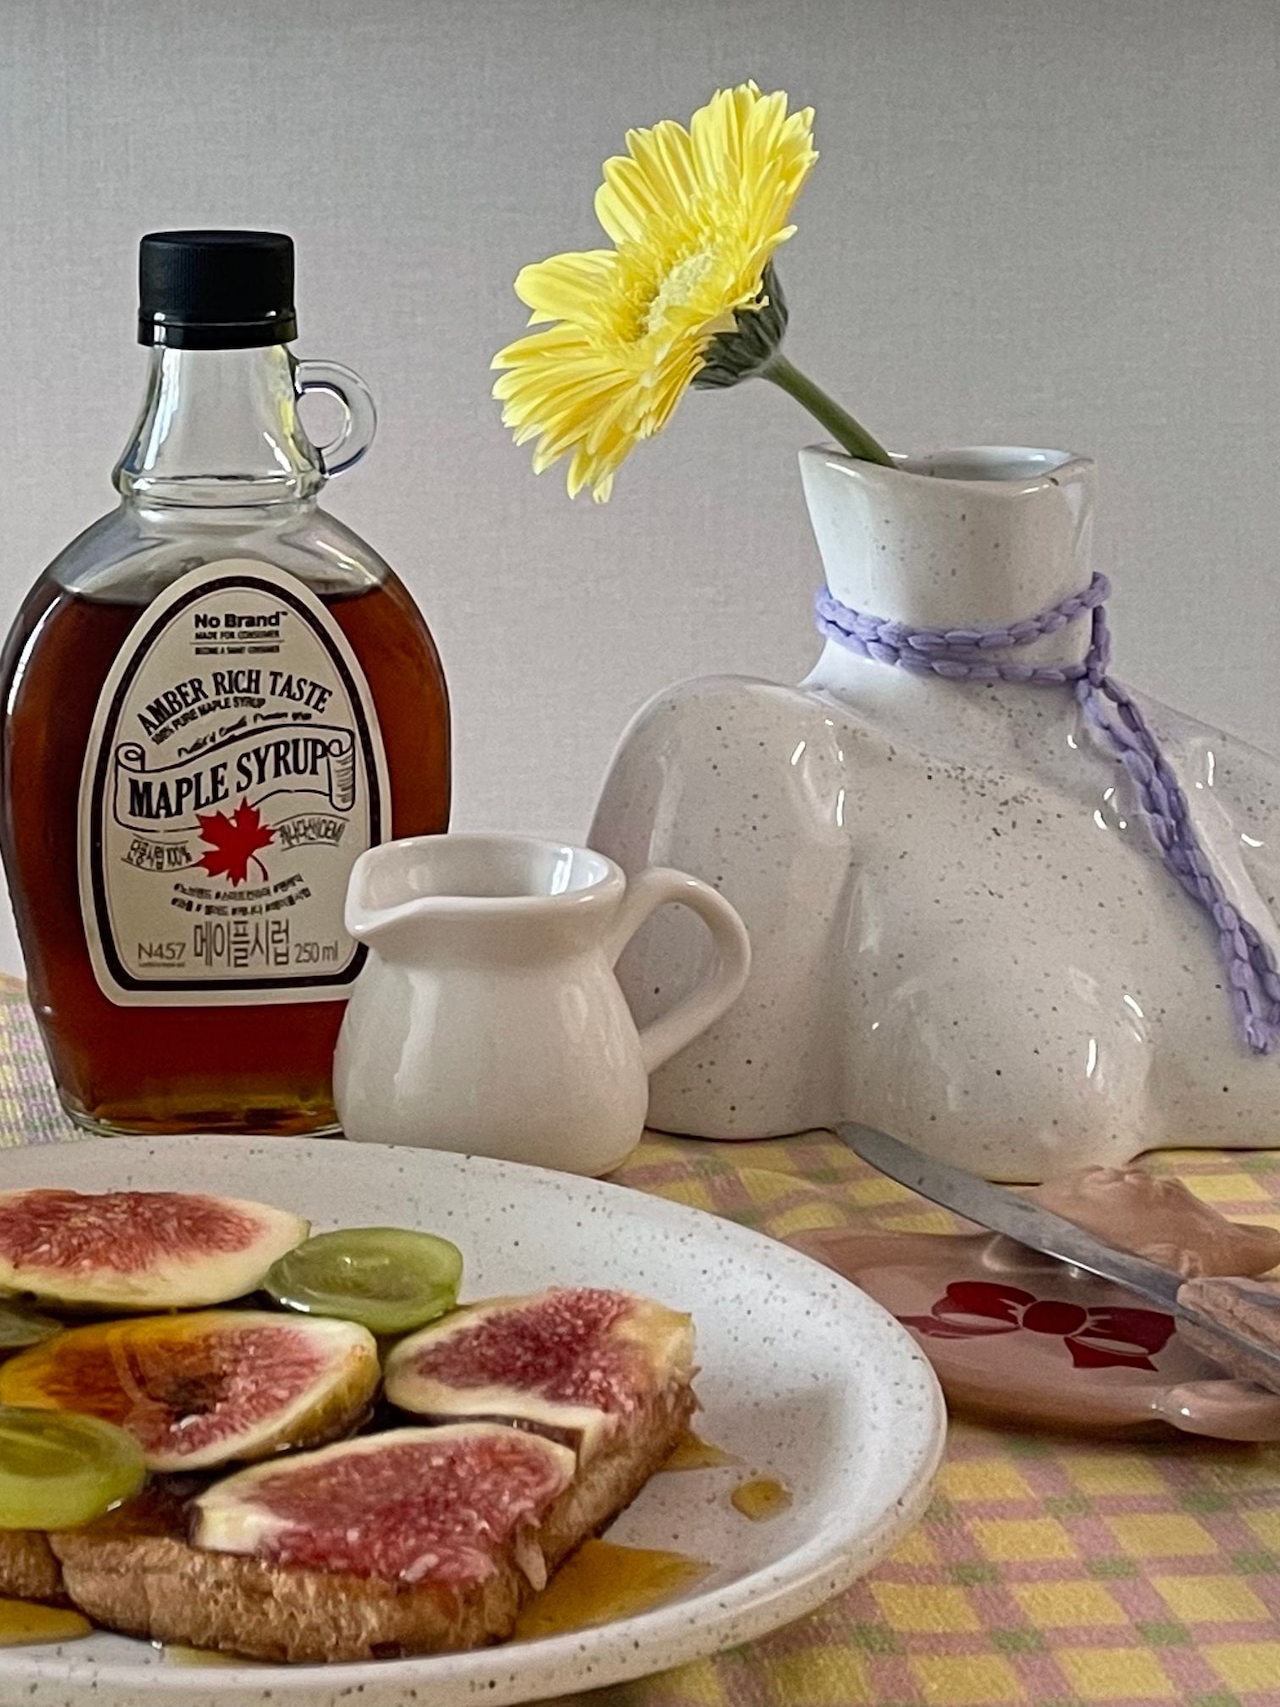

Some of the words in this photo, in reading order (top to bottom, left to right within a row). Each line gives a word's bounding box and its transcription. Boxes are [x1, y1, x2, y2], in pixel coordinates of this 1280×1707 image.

[194, 613, 221, 628] No
[137, 678, 209, 736] AMBER
[212, 669, 262, 696] RICH
[269, 670, 333, 714] TASTE
[171, 708, 199, 731] PURE
[197, 697, 231, 718] MAPLE
[233, 696, 266, 709] SYRUP
[128, 761, 230, 819] MAPLE
[236, 737, 328, 793] SYRUP
[137, 942, 187, 961] N457
[193, 918, 290, 968] 메이플시럽
[293, 942, 320, 963] 250
[322, 940, 339, 962] ml
